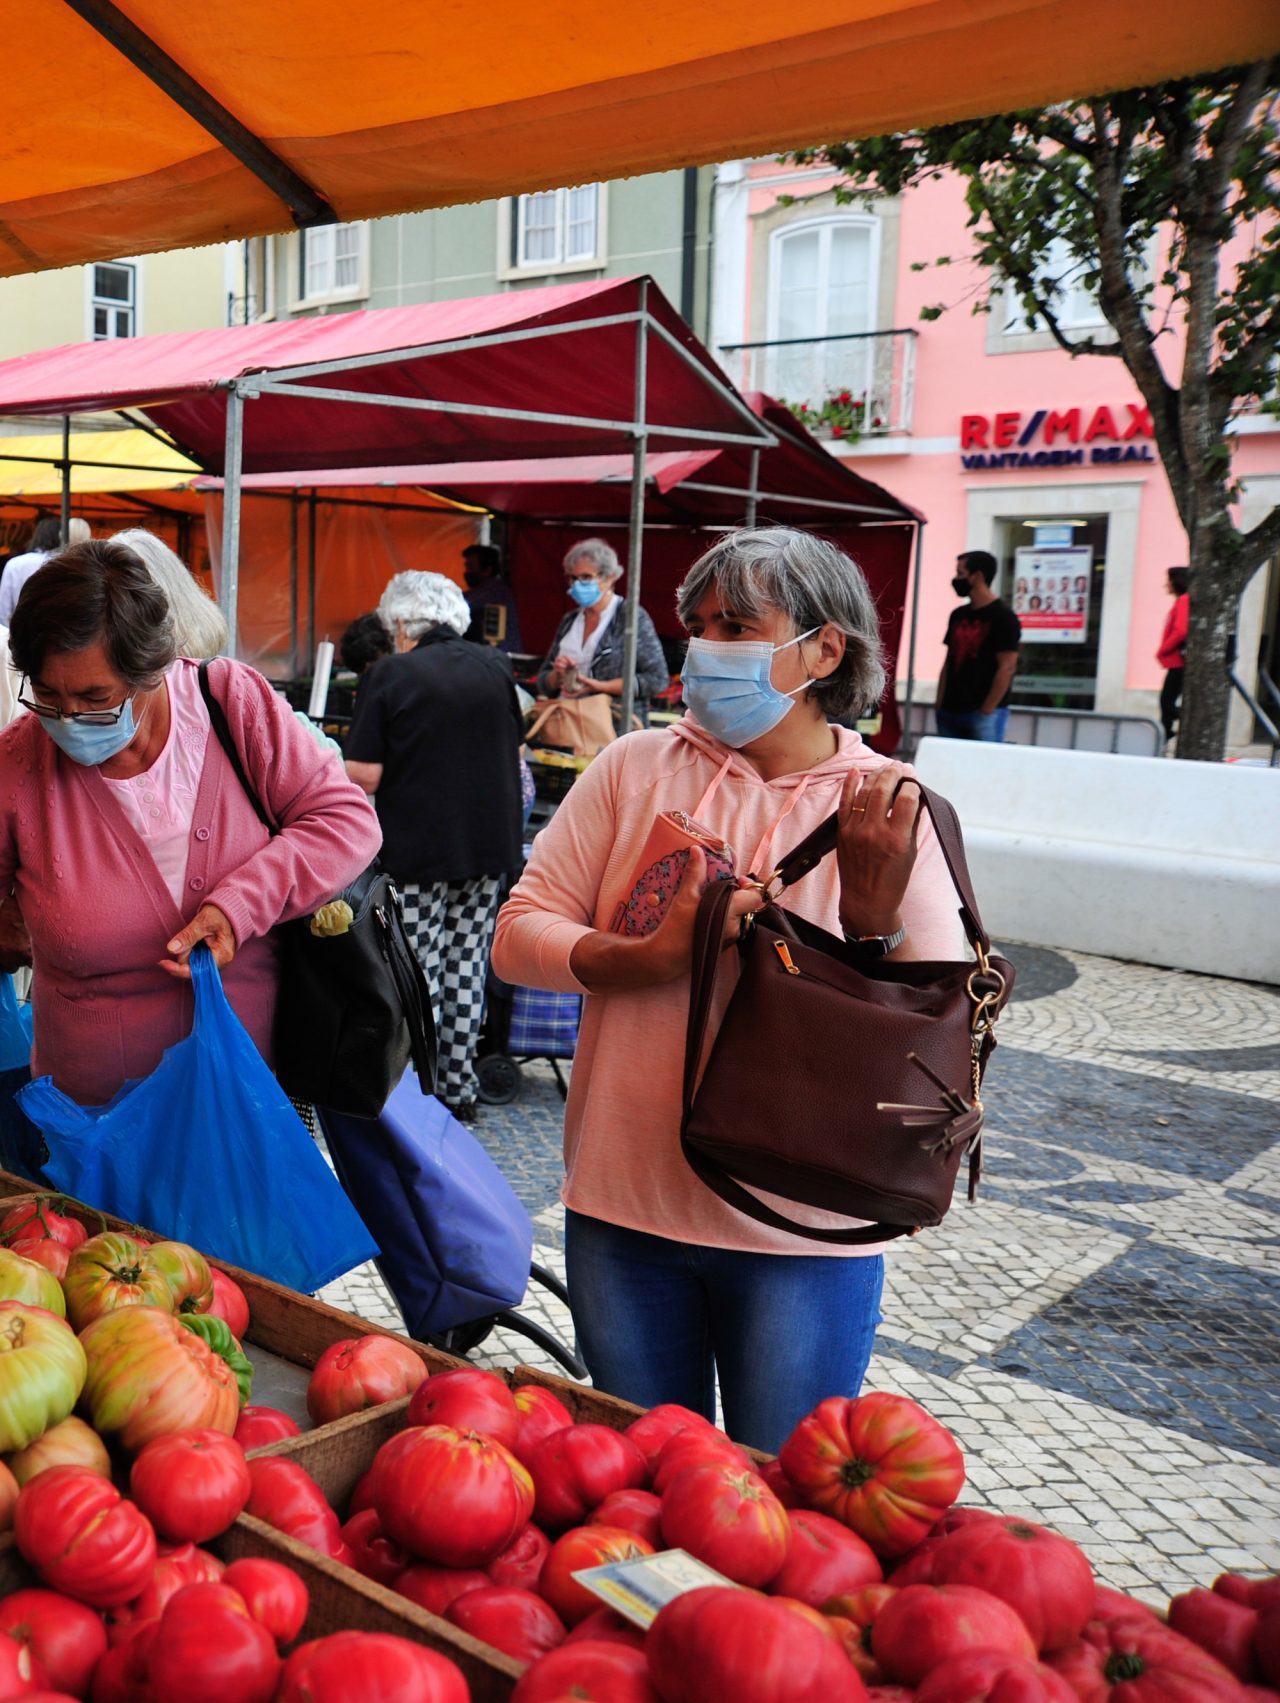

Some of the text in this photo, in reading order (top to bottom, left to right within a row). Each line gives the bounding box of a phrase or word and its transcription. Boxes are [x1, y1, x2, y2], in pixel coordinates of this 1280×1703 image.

[960, 404, 1154, 449] RE/MAX
[960, 445, 1155, 470] VANTAGEM REAL
